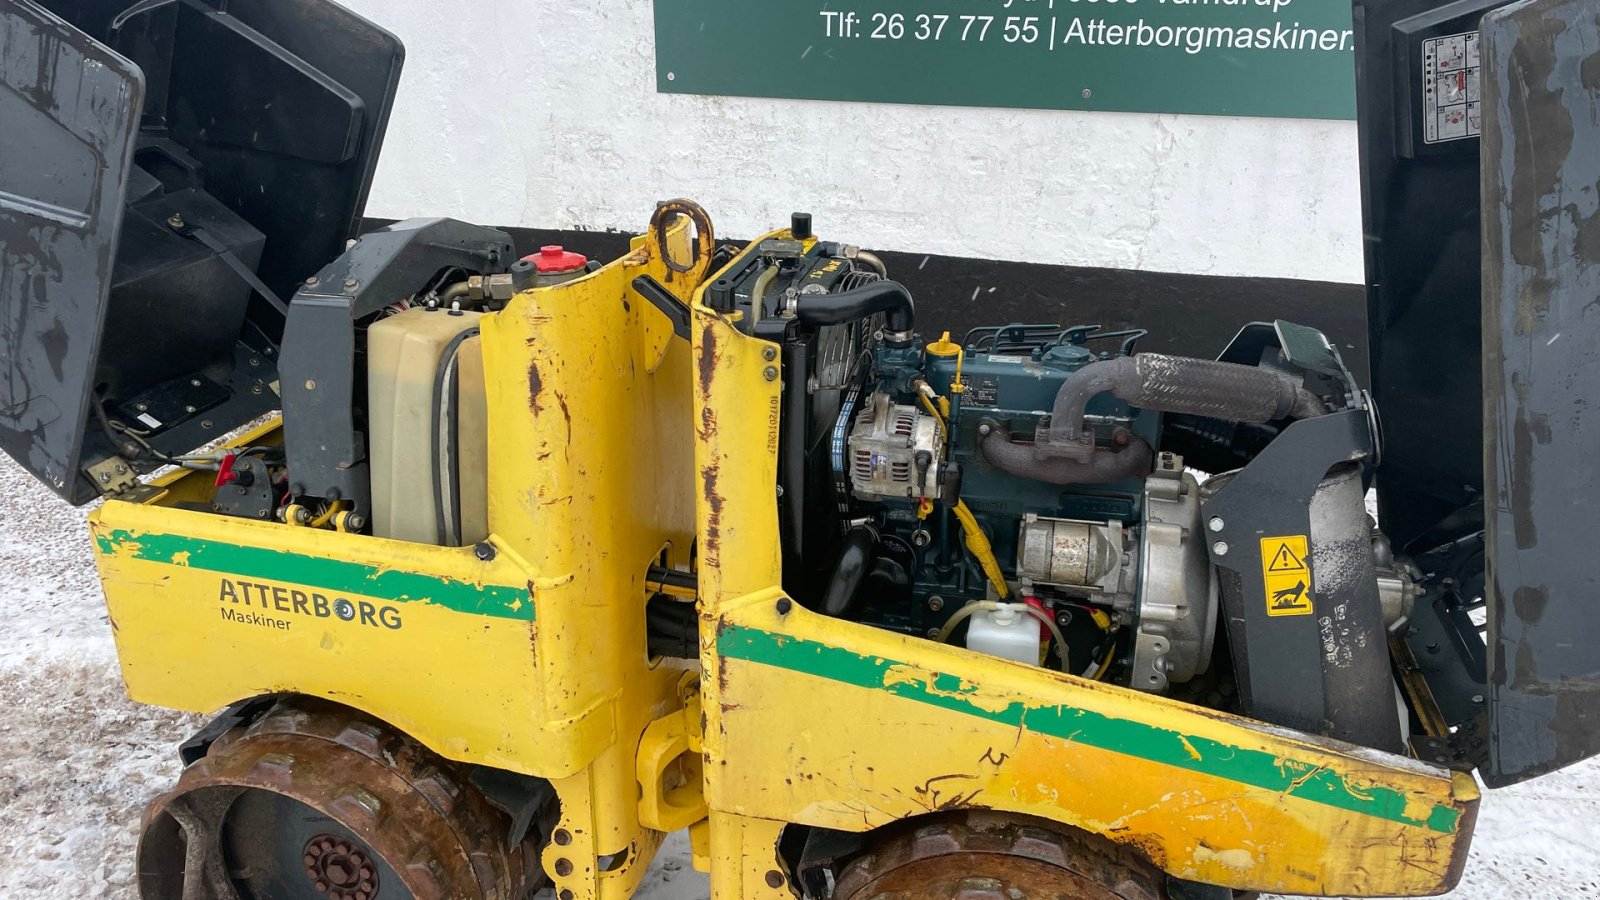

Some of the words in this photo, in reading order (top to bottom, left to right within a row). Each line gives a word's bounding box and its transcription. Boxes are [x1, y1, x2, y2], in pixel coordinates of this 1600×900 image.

[819, 11, 860, 38] Tlf:
[870, 12, 905, 40] 26
[914, 13, 949, 41] 37
[959, 15, 994, 42] 77
[1003, 16, 1039, 43] 55
[219, 578, 402, 630] ATTERBORG
[220, 607, 292, 631] Maskiner
